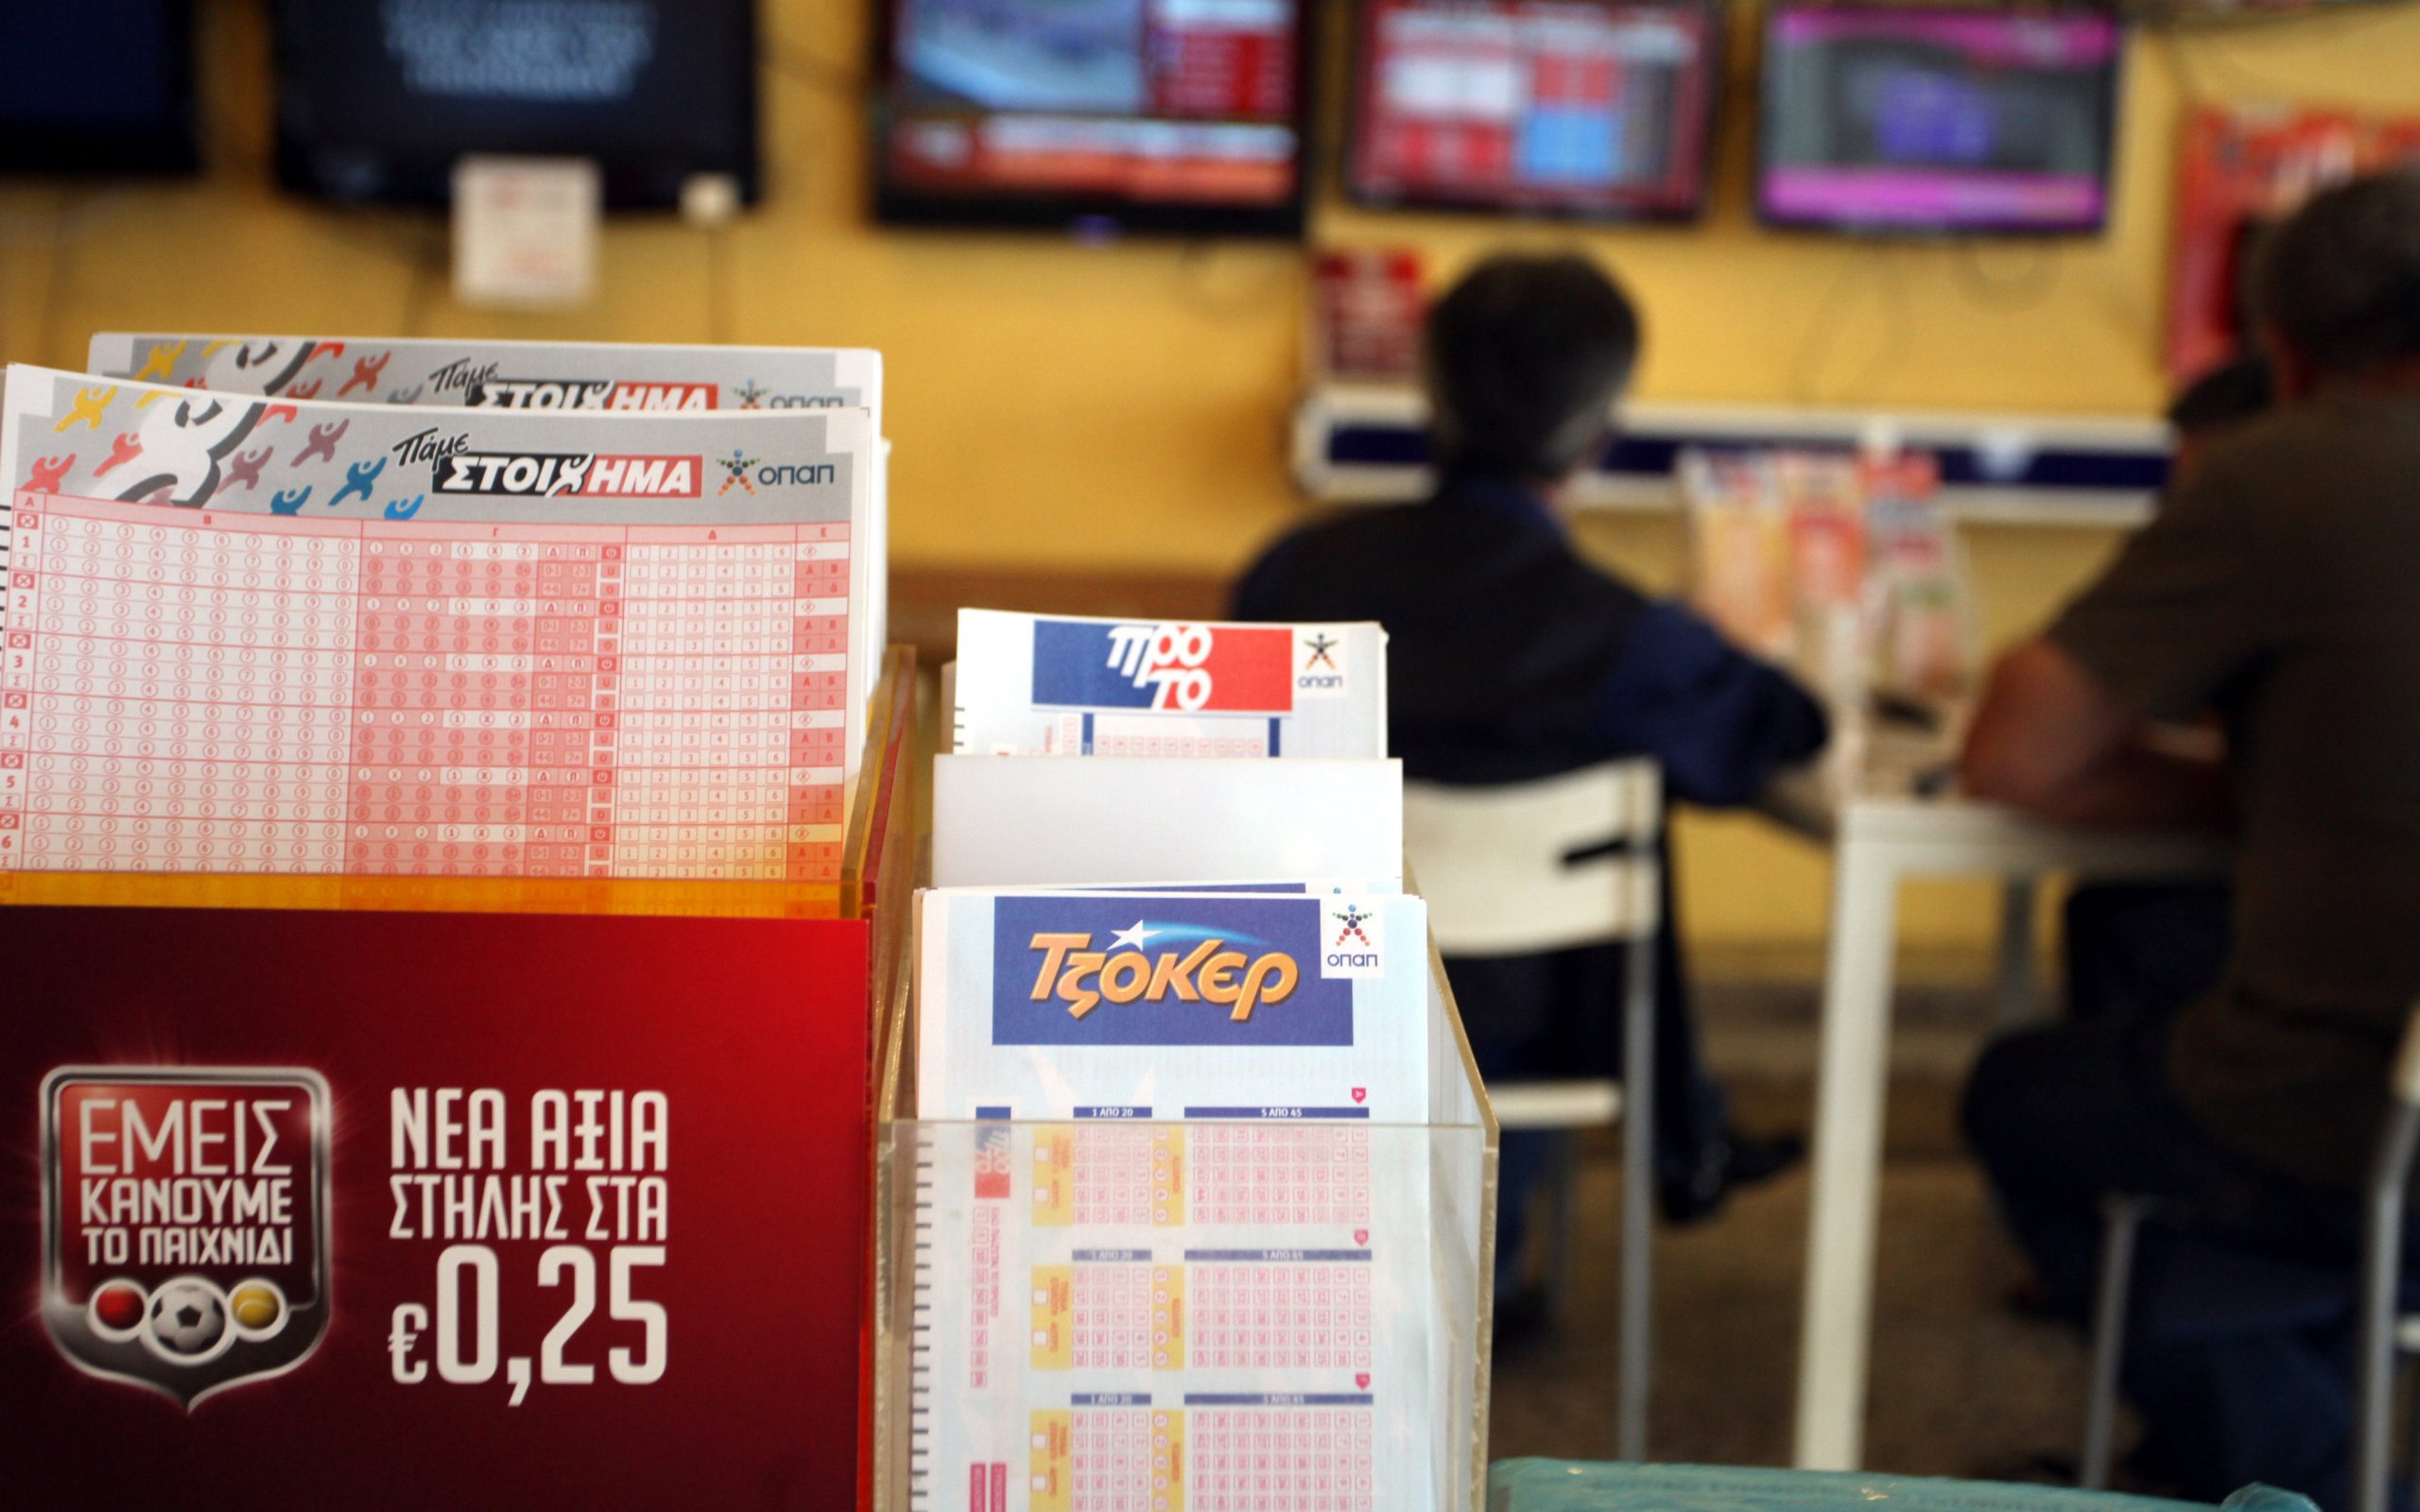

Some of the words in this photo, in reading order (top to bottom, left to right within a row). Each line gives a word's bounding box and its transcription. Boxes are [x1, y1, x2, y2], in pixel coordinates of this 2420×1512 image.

[428, 357, 499, 397] Πάμε
[392, 427, 469, 470] Πάμε
[441, 454, 692, 497] ΣΤΟΙΧΗΜΑ
[23, 536, 29, 548] 1
[18, 595, 27, 609] 2
[14, 655, 23, 668] 3
[9, 715, 19, 729] 4
[7, 775, 15, 788] 5
[2, 835, 11, 849] 6
[1099, 1108, 1119, 1117] ΑΠΟ
[1122, 1108, 1133, 1117] 20
[1269, 1108, 1288, 1117] ΑΠΟ
[1290, 1108, 1302, 1117] 45
[80, 1099, 292, 1176] ΕΜΕΙΣ
[390, 1087, 507, 1170] ΝΕΑ
[530, 1089, 667, 1172] ΑΞΙΑ
[81, 1178, 292, 1225] ΚΑΝΟΥΜΕ
[389, 1174, 568, 1240] ΣΤΗΛΗΣ
[584, 1176, 667, 1241] ΣΤΑ
[81, 1228, 129, 1265] ΤΟ
[139, 1227, 293, 1265] ΠΑΙΧΝΙΔΙ
[388, 1244, 668, 1407] €0,25
